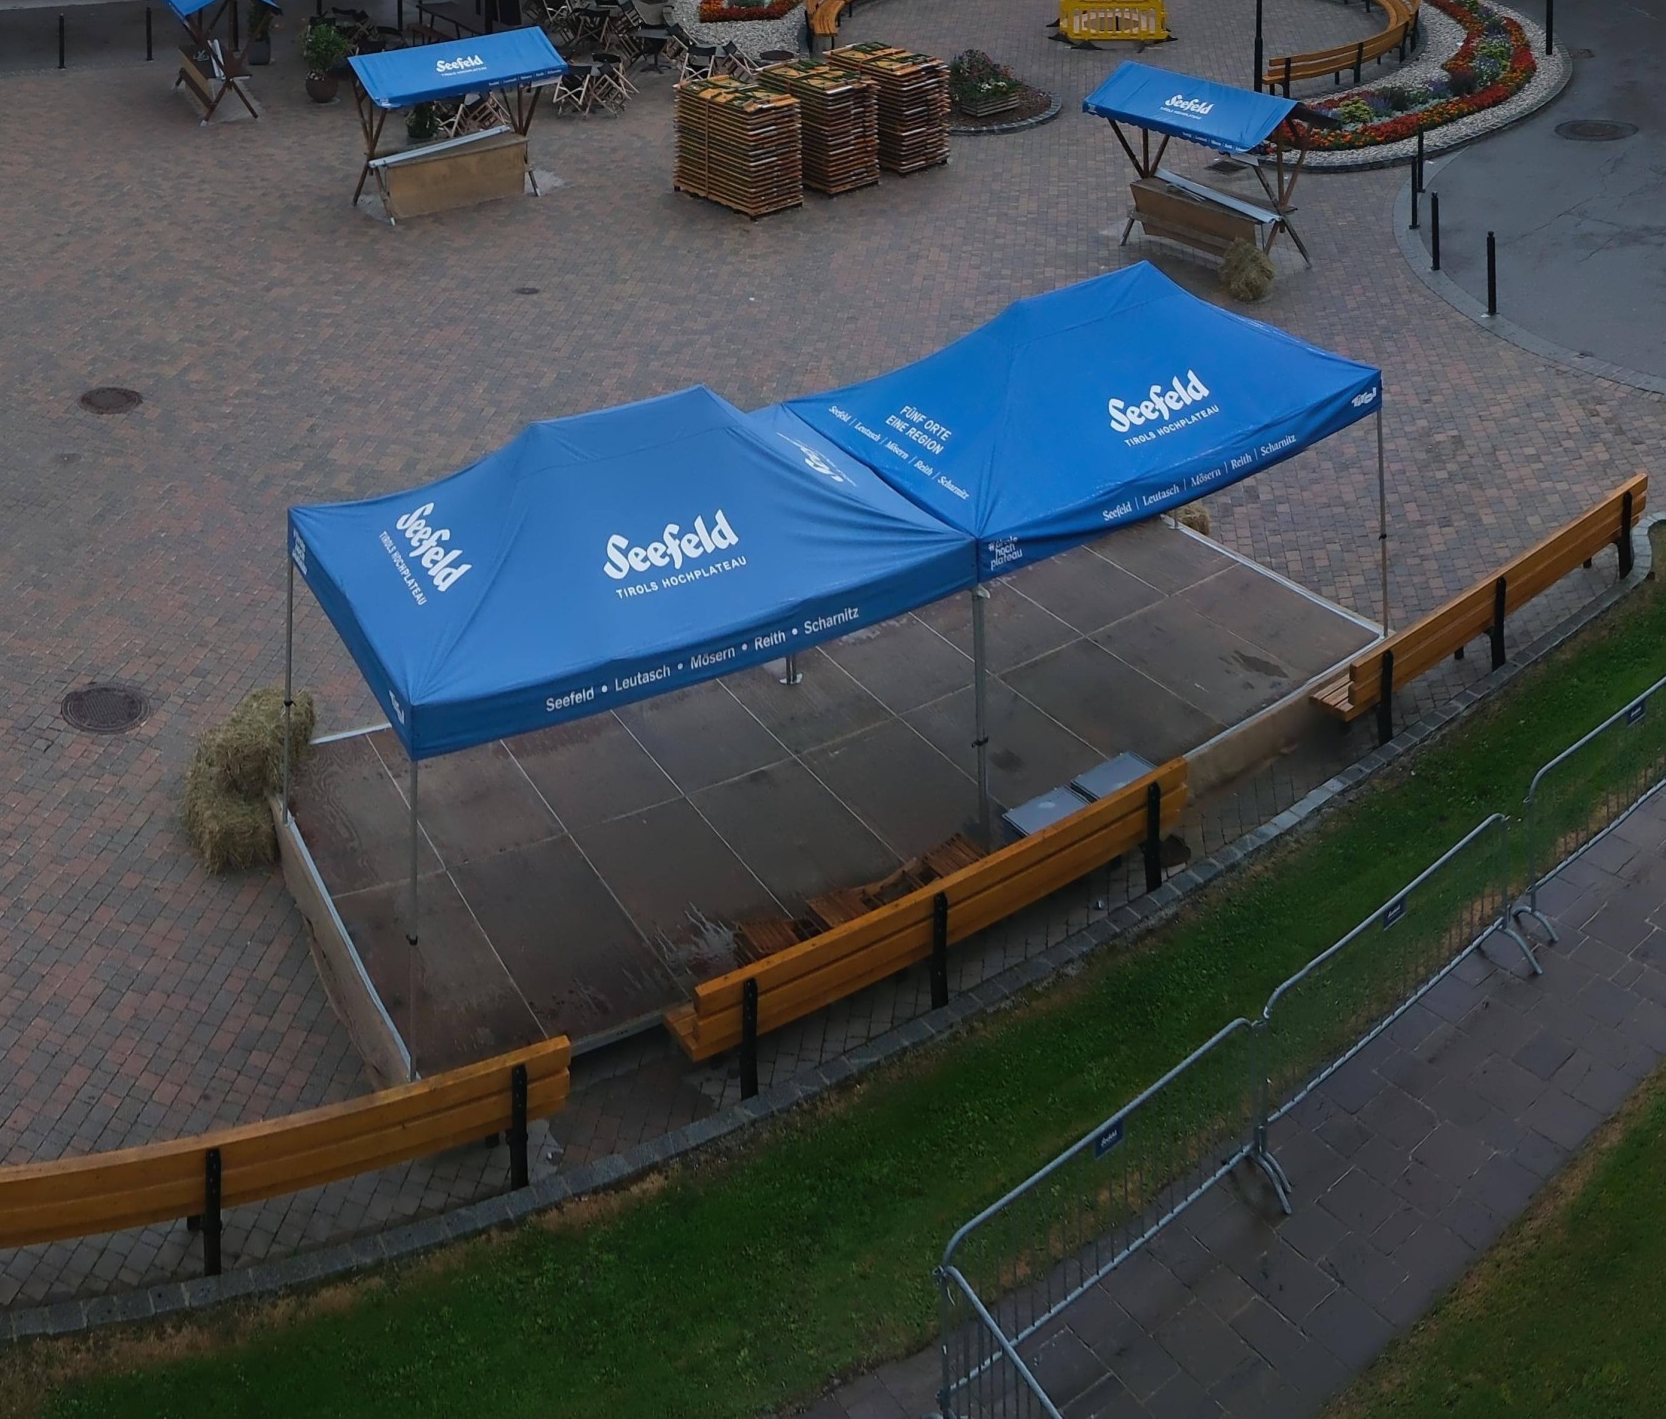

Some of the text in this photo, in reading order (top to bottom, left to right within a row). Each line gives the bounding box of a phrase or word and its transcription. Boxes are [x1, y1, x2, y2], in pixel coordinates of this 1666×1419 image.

[436, 54, 484, 72] Seefeld
[1164, 94, 1216, 115] Seefeld
[1108, 369, 1210, 433] Seefeld
[885, 414, 944, 455] EINE REGION
[899, 405, 952, 442] FÜNF ORTE
[1124, 404, 1220, 448] TIROLS HOCHPLATEAU
[1102, 434, 1296, 522] Seefeld Leutasch Mösern Reith Scharnitz
[396, 502, 473, 592] Seefeld
[603, 508, 739, 580] Seefeld
[990, 548, 1023, 571] plateau
[995, 542, 1016, 560] hoch
[378, 531, 428, 606] TIROLS HOCHPLATEAU
[615, 555, 748, 600] TIROLS HOCHPLATEAU
[546, 606, 860, 712] Seefeld Leutasch Mösern Reith Scharnitz
